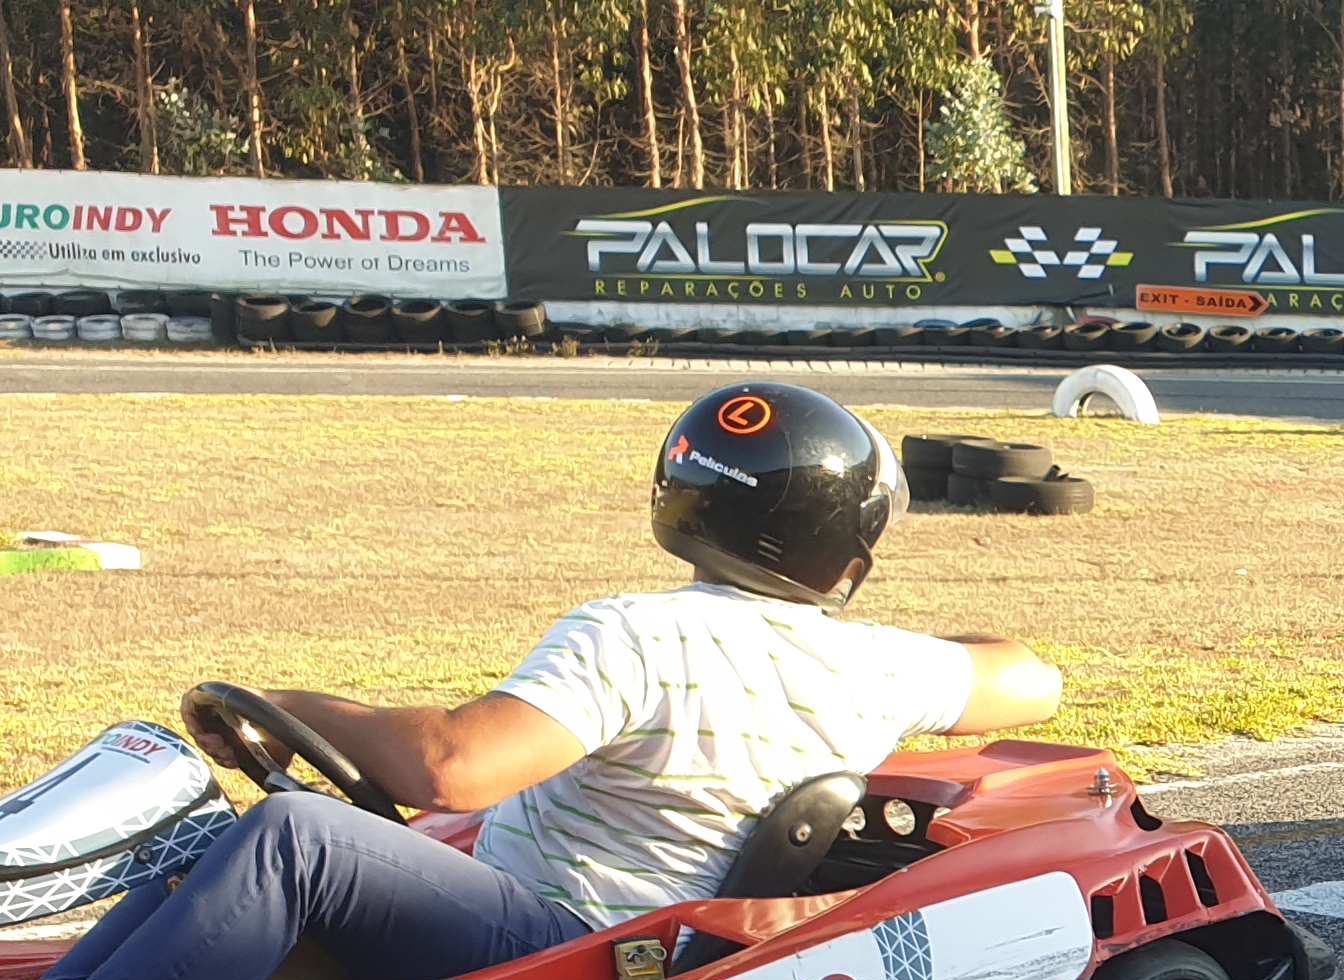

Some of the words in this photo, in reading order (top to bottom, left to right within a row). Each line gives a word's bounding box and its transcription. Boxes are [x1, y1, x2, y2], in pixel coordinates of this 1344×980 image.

[210, 204, 487, 243] HONDA
[49, 242, 97, 261] Utiliza
[102, 248, 125, 262] em
[131, 245, 201, 264] exclusivo
[576, 219, 944, 277] PALOCAR
[239, 248, 281, 269] The
[288, 251, 354, 271] Power
[361, 251, 379, 272] of
[388, 254, 470, 273] Dreams
[594, 277, 808, 300] REPARAÇÕES
[840, 283, 922, 300] AUTO
[1140, 292, 1179, 305] EXIT
[1197, 295, 1247, 309] SAÍDA
